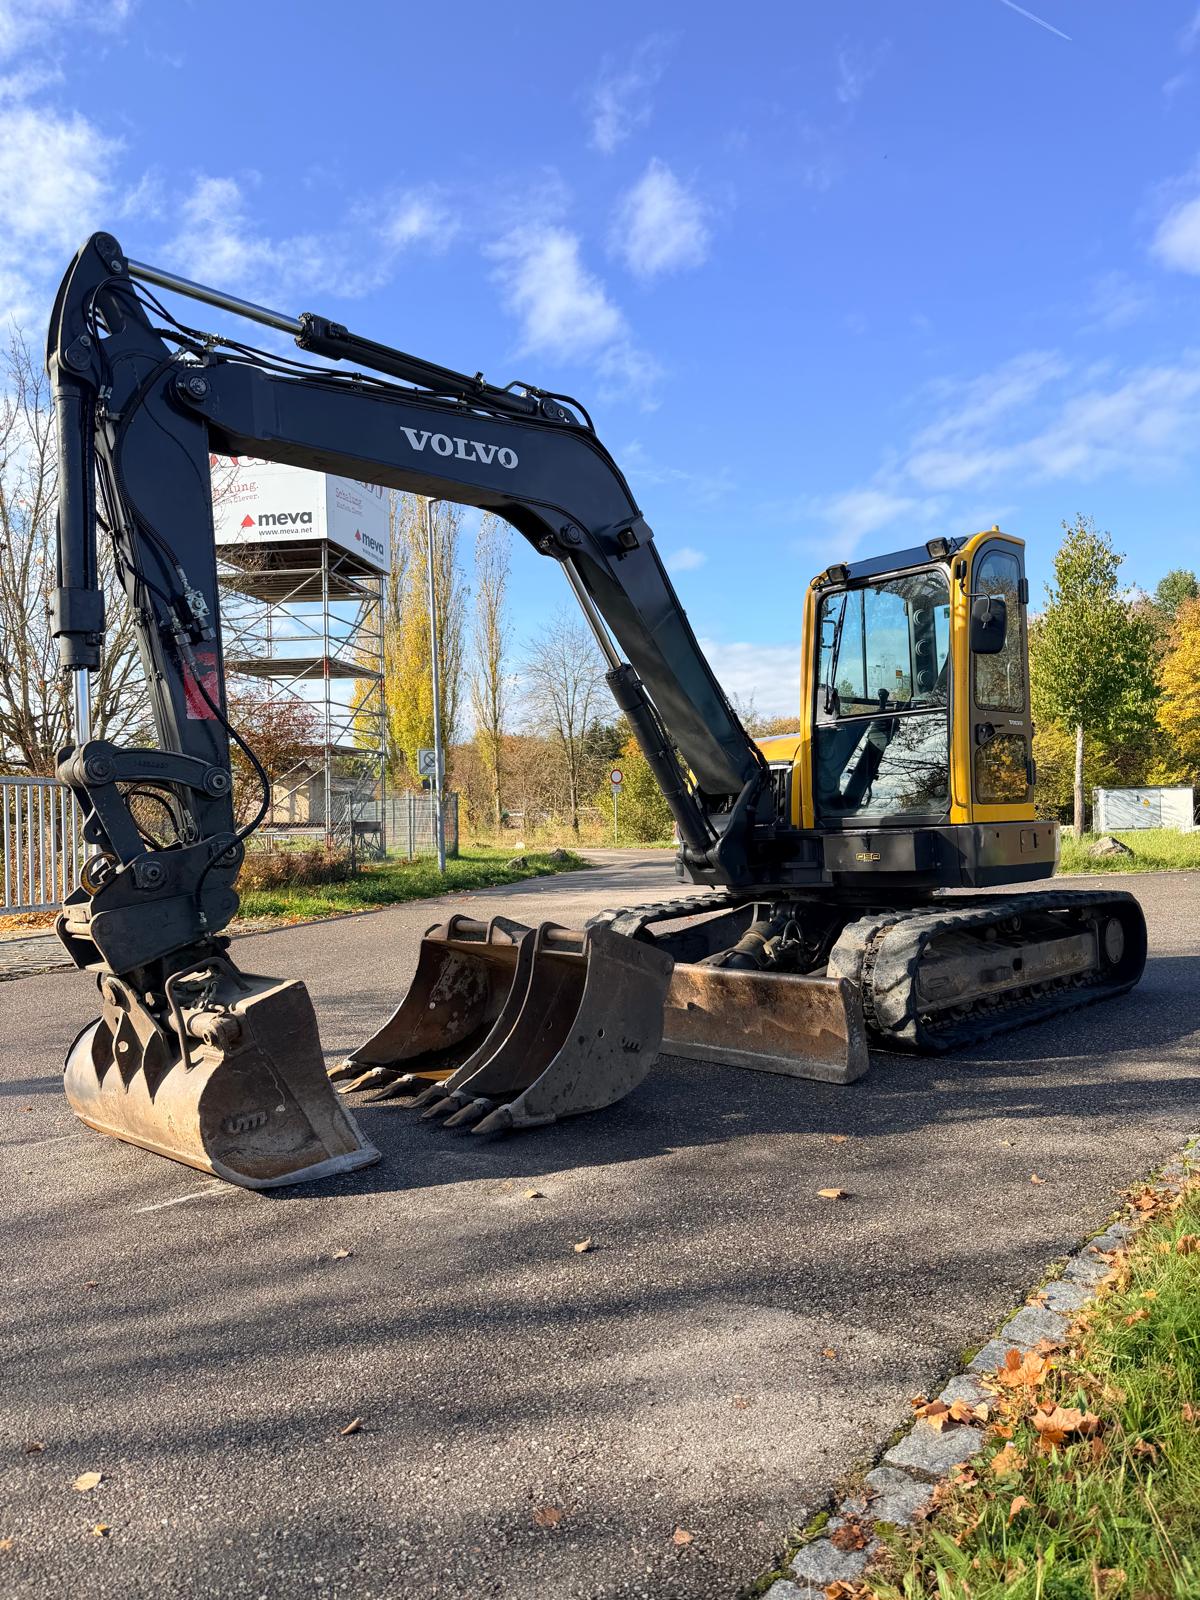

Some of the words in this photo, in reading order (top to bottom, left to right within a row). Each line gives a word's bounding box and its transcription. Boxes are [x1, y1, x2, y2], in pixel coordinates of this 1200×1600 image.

[400, 426, 519, 469] VOLVO
[258, 511, 312, 526] meva
[258, 527, 312, 536] www.meva.net
[362, 532, 384, 555] meva
